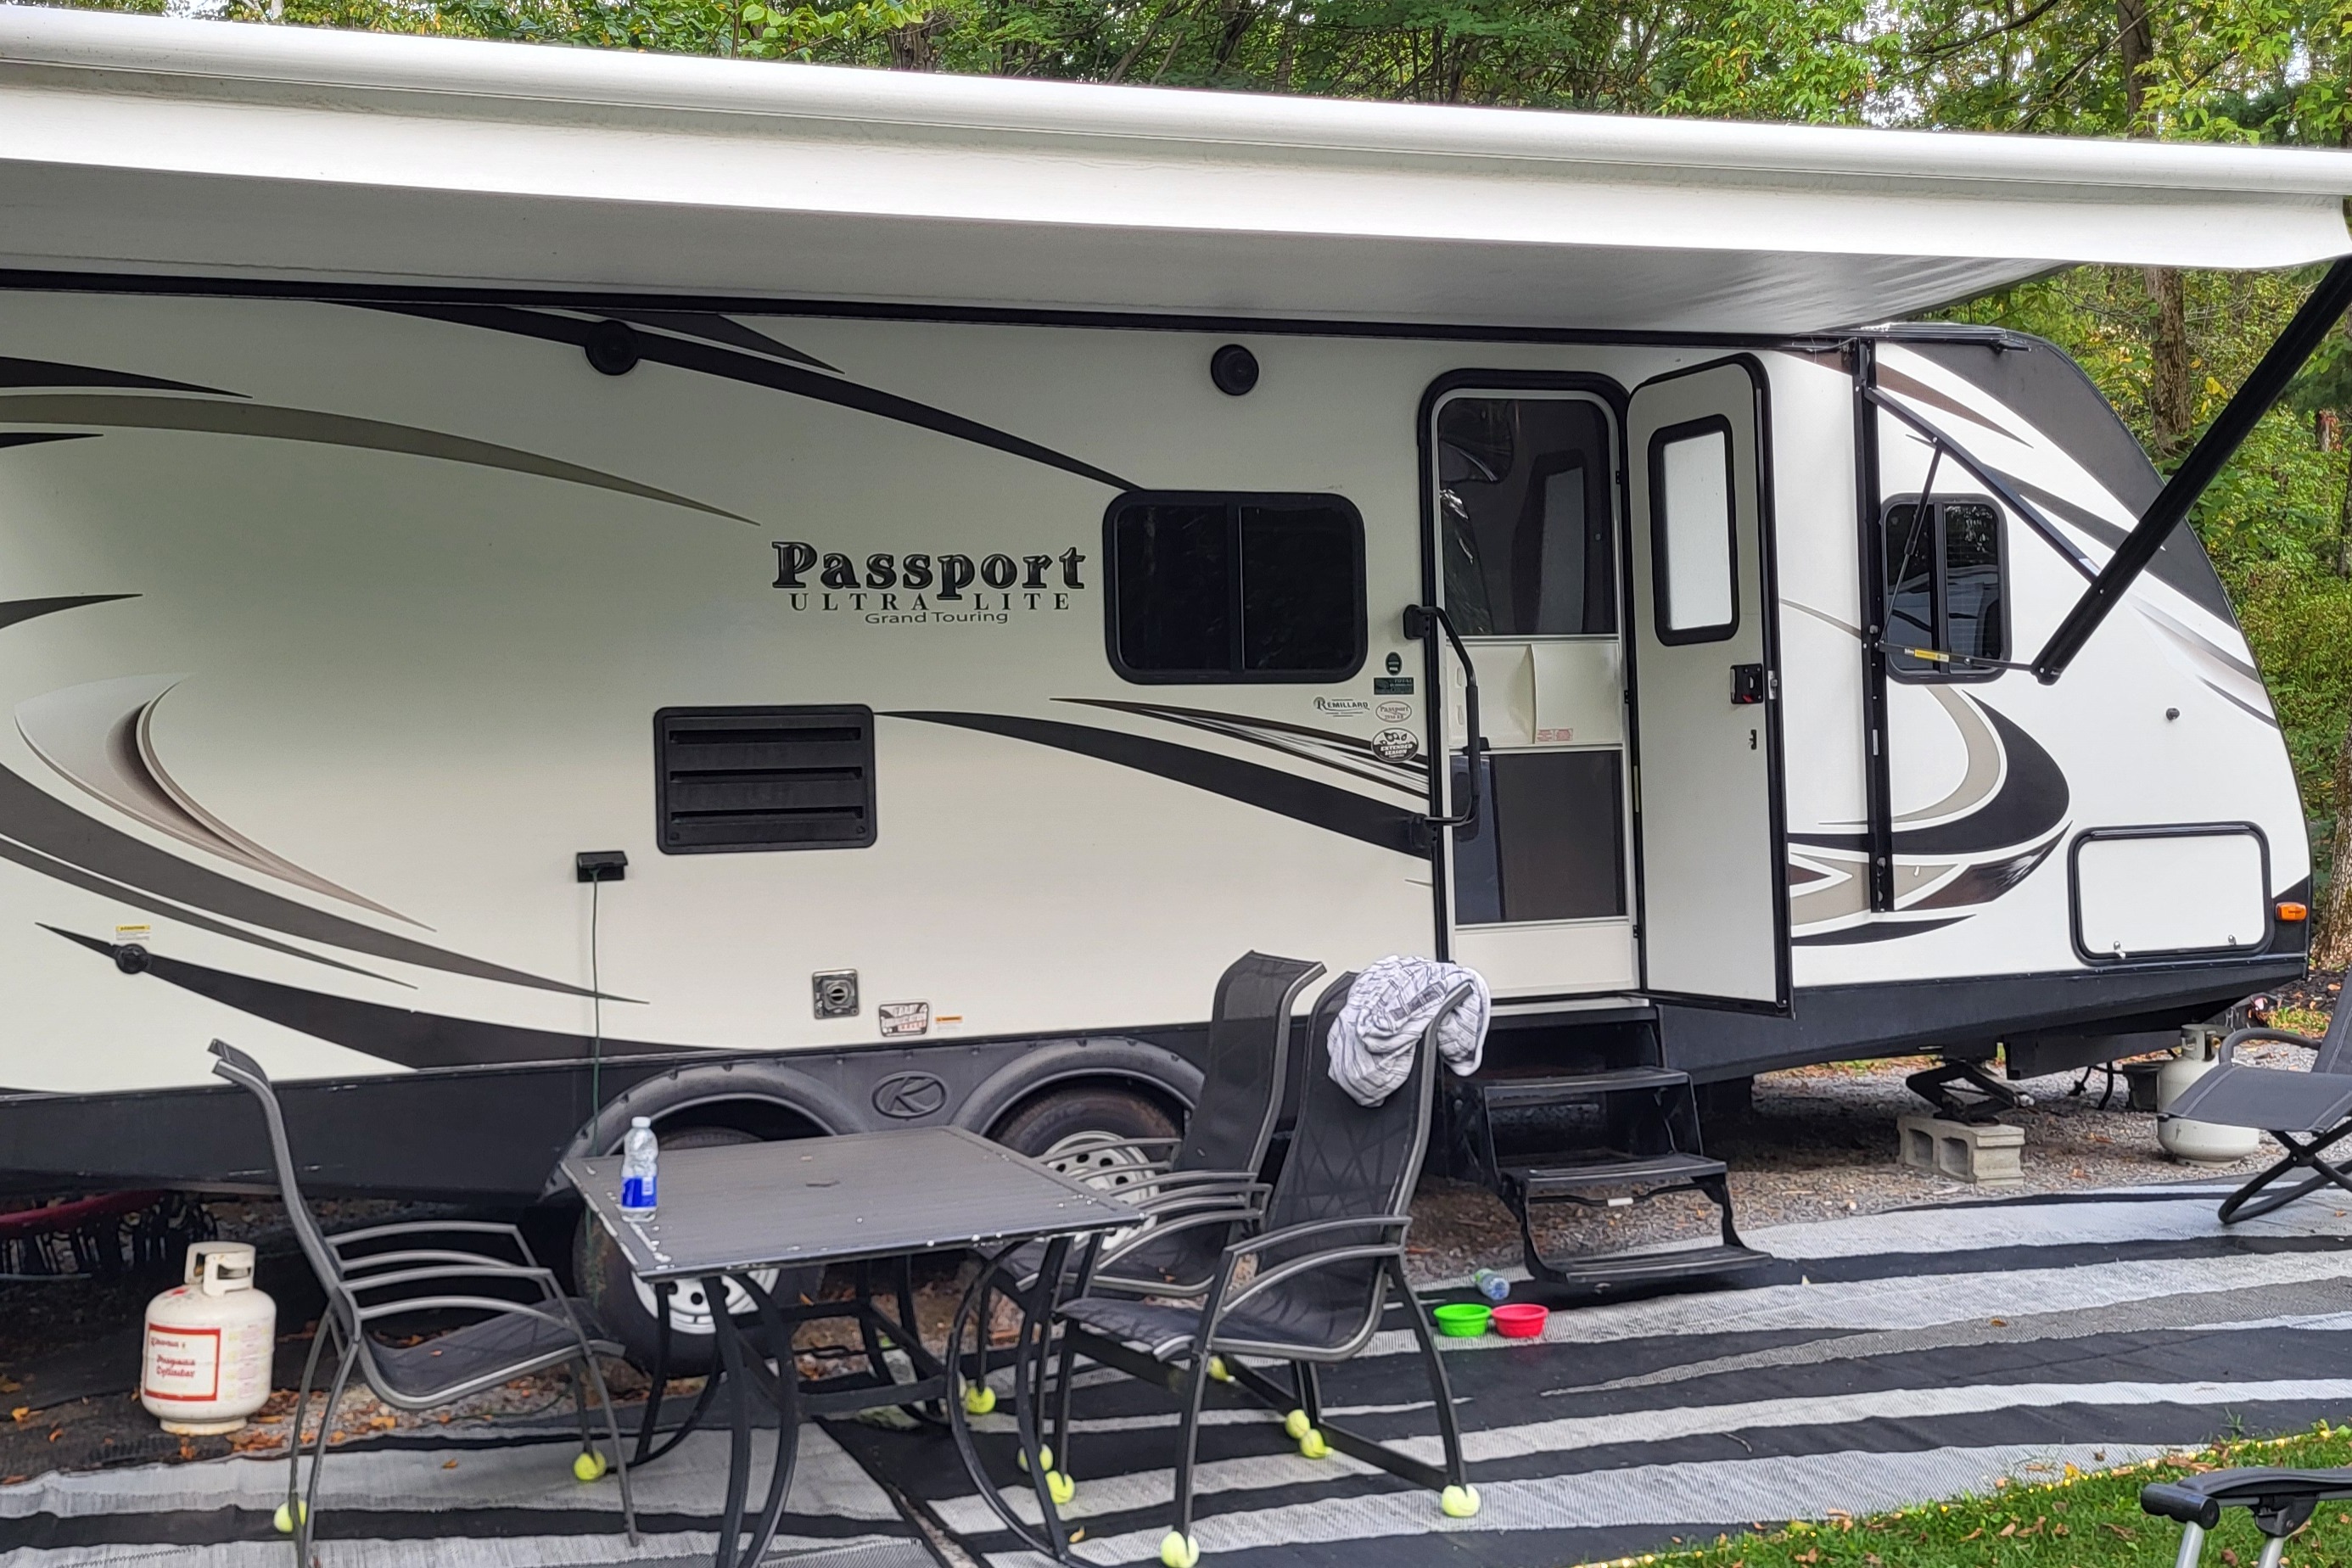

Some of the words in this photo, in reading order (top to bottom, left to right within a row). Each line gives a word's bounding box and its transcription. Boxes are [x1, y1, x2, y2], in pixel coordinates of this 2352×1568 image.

[771, 540, 1087, 601] Passport
[790, 592, 929, 612] ULTRA
[973, 592, 1070, 612] LITE
[864, 611, 927, 624] Grand
[932, 611, 1009, 624] Touring
